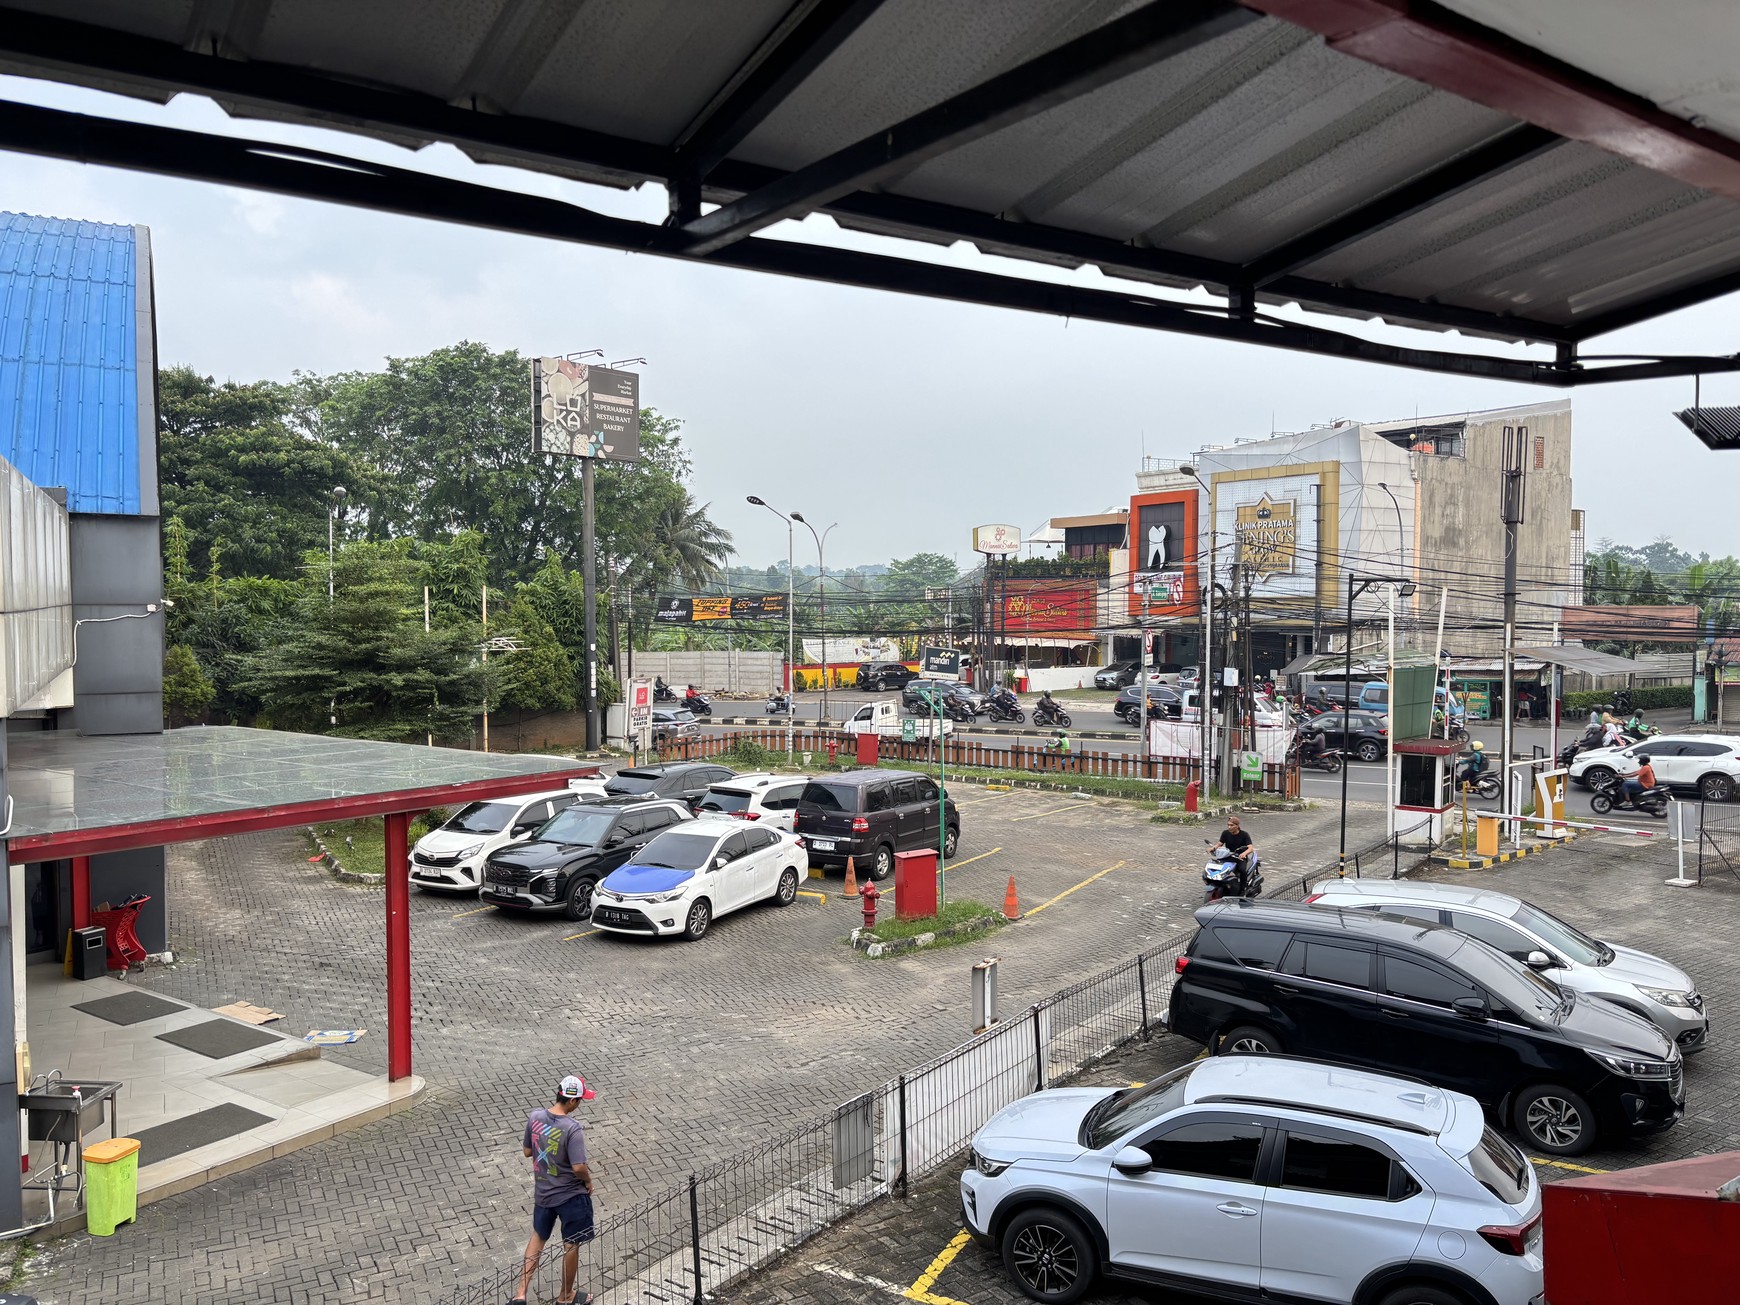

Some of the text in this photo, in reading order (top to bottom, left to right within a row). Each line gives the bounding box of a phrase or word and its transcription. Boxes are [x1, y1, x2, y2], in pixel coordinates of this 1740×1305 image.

[593, 403, 634, 415] SUPERMARKET
[596, 413, 631, 424] RESTAURANT
[603, 423, 624, 432] BAKERY
[1234, 519, 1294, 531] KLINIK PRATAMA
[640, 707, 648, 715] IN
